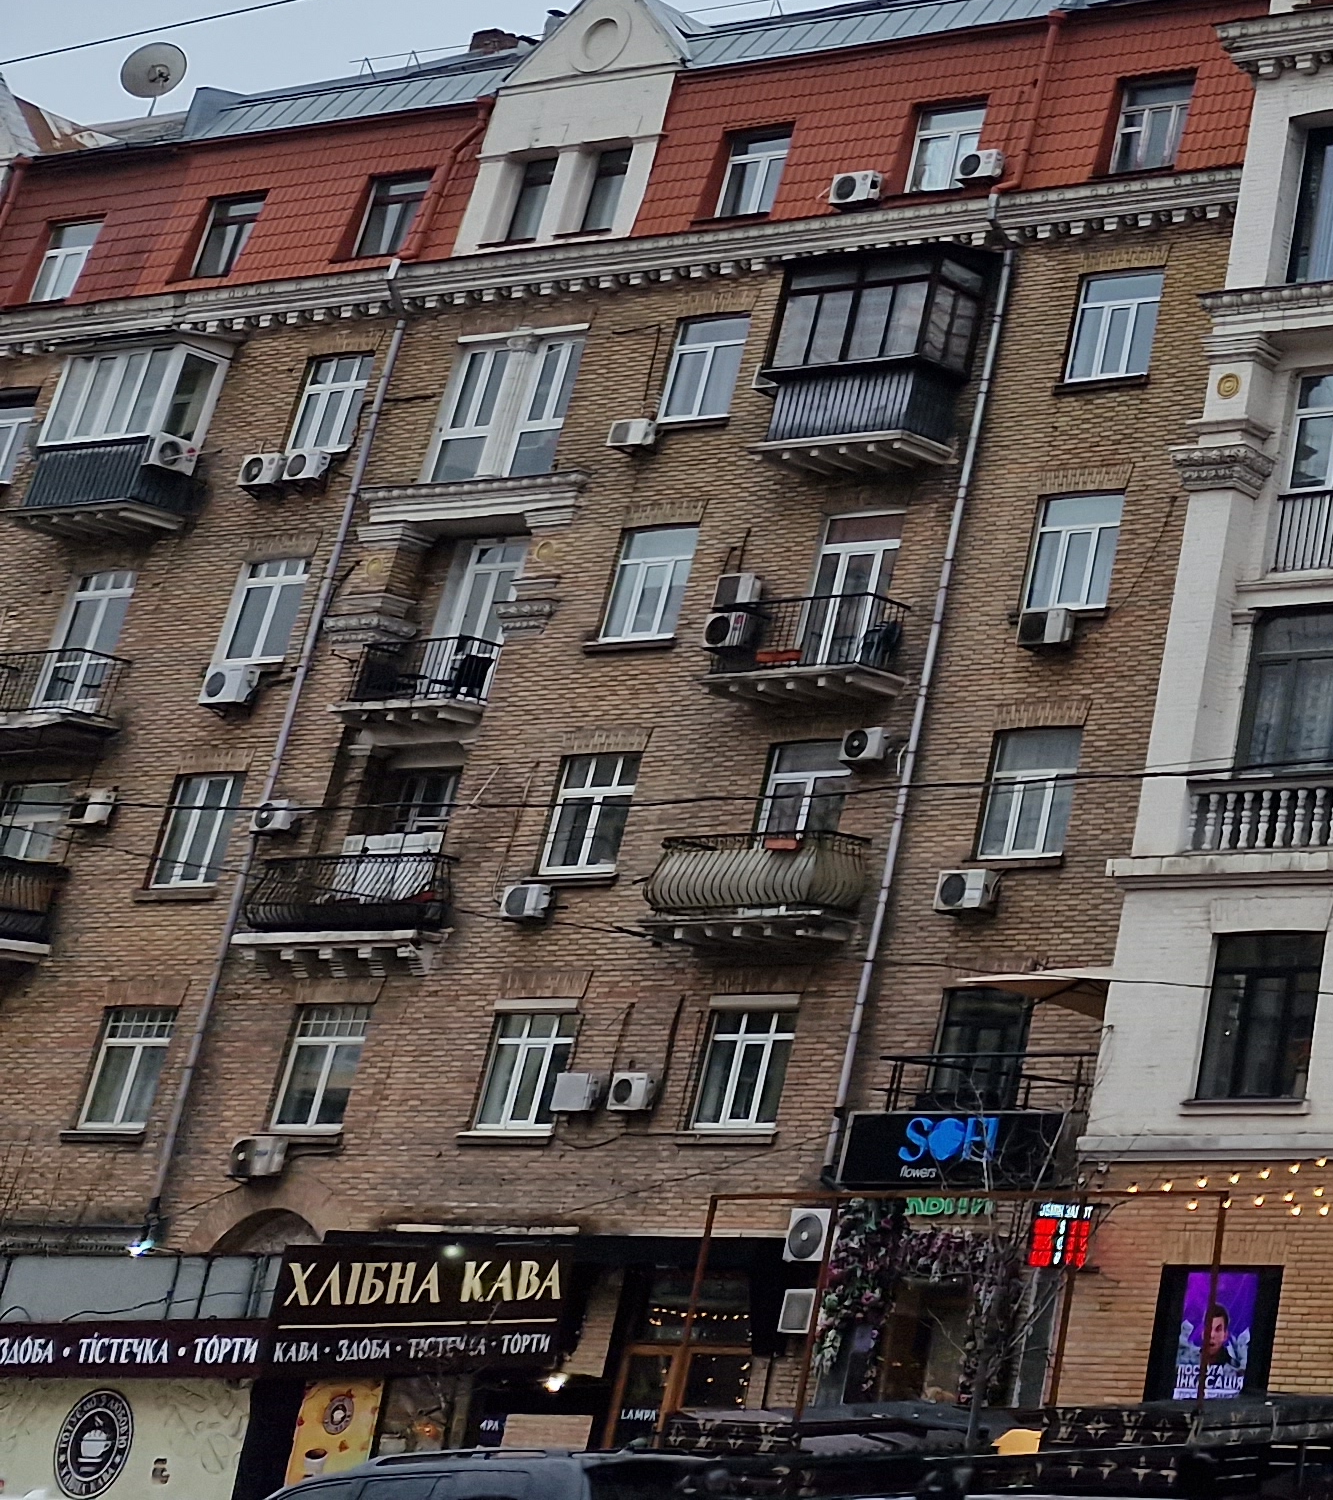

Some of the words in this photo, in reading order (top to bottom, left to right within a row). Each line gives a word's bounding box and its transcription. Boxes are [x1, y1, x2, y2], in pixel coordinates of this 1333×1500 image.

[900, 1165, 936, 1178] flowers
[284, 1261, 440, 1306] ХЛІБНА
[460, 1259, 560, 1302] КАВА
[78, 1332, 169, 1364] ТІСТЕЧКА
[193, 1335, 259, 1364] ТОРТИ
[273, 1340, 318, 1363] КАВА
[336, 1337, 390, 1361] ЗДОБА
[501, 1332, 550, 1355] ТОРТИ
[1177, 1364, 1224, 1376] ПОСУГА
[621, 1409, 656, 1422] LAMPA
